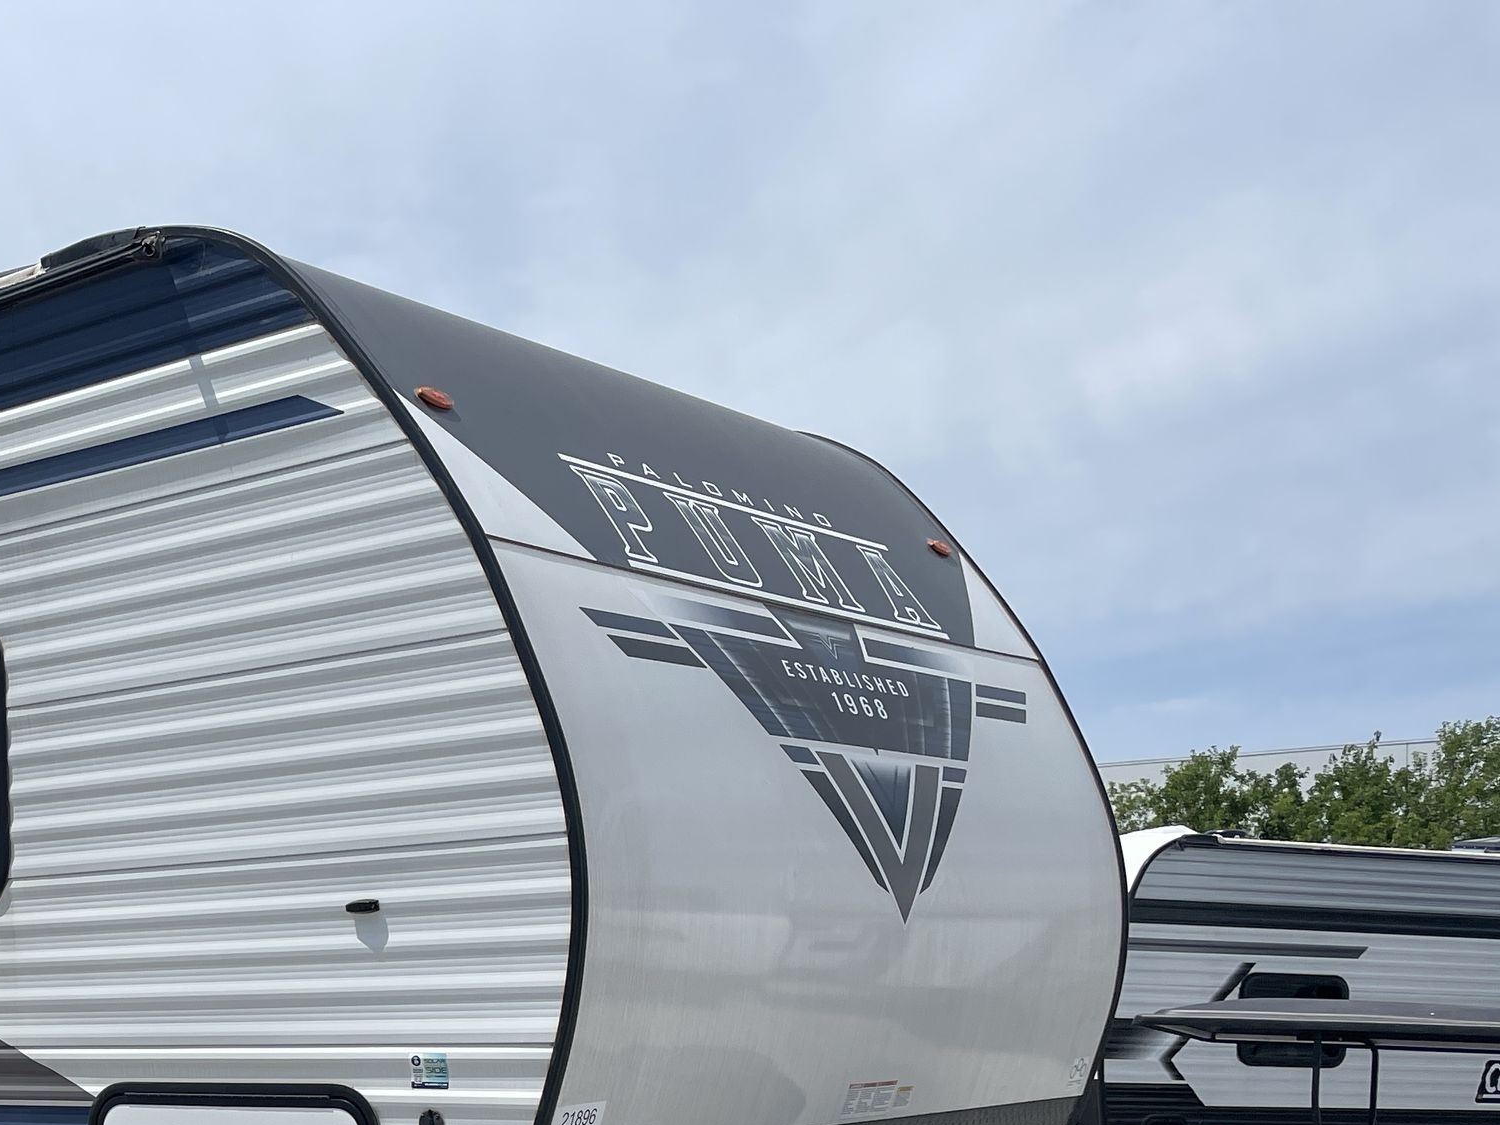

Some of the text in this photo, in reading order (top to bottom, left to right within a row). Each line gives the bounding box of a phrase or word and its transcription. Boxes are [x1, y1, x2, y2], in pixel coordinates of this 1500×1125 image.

[607, 453, 833, 528] PALOMINO
[571, 465, 943, 631] PUMA
[781, 659, 909, 697] ESTABLISHED
[831, 691, 888, 720] 1968
